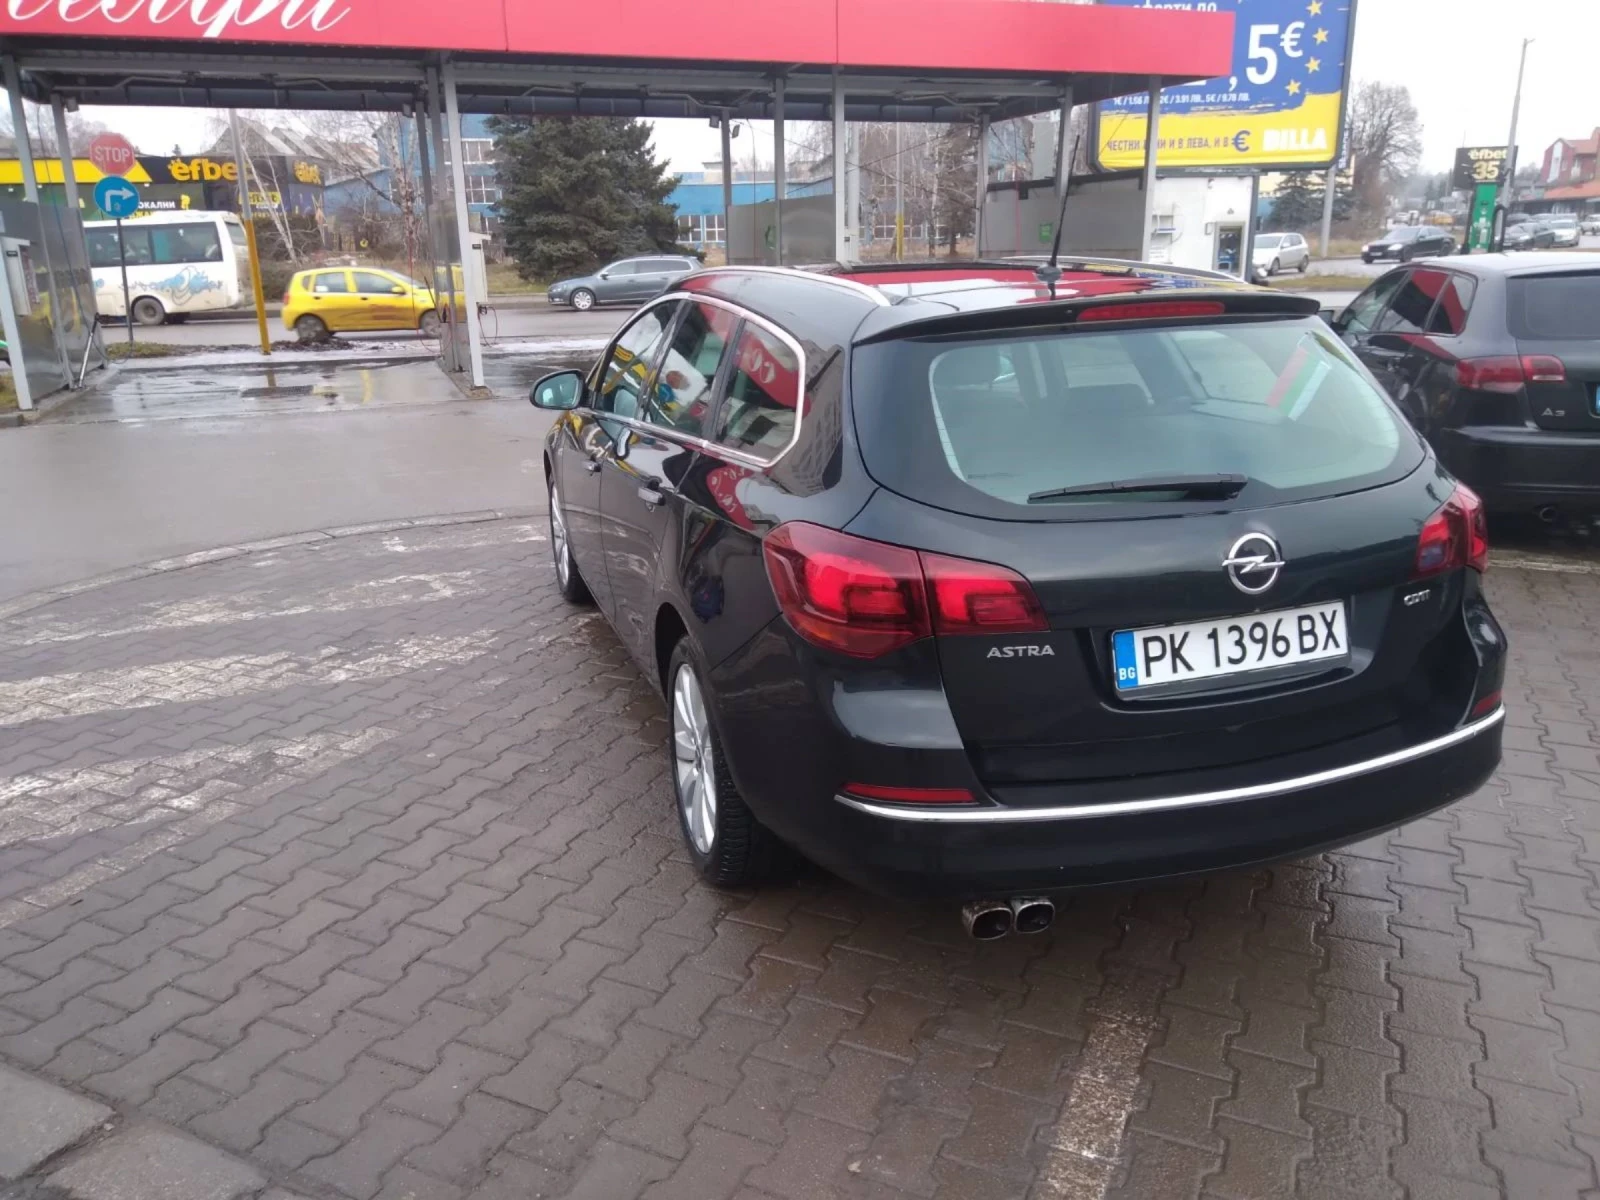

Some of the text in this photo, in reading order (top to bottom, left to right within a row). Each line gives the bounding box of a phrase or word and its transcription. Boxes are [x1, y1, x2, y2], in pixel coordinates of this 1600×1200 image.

[1107, 139, 1140, 151] ЧЕСТНИ
[1169, 138, 1175, 149] И
[1262, 128, 1328, 151] BILLA
[94, 145, 131, 162] STOP
[168, 155, 243, 181] efbe
[1472, 160, 1500, 180] 35
[138, 201, 176, 209] ОКАЛНИ
[1541, 407, 1565, 417] A3
[987, 645, 1055, 658] ASTRA
[1142, 609, 1341, 678] PK 1396 BX
[1118, 666, 1136, 681] BG
